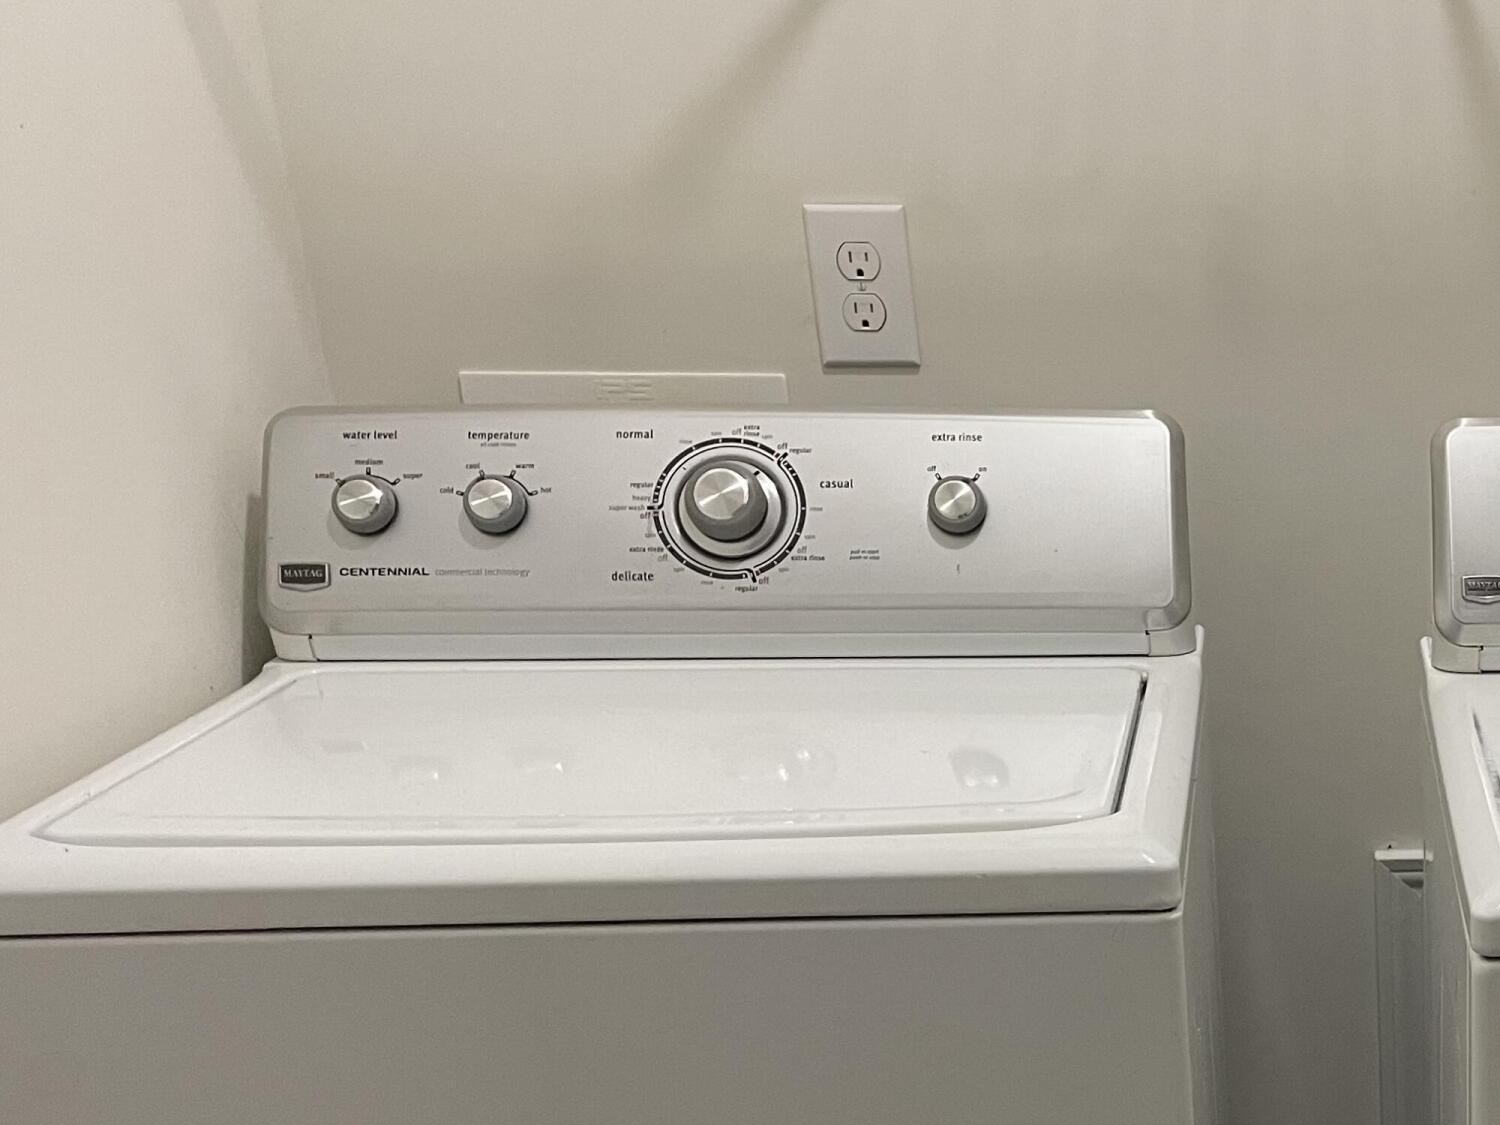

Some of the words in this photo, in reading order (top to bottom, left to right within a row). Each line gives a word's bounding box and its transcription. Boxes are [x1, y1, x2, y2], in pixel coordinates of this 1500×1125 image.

[343, 431, 371, 440] water
[373, 430, 398, 440] level
[468, 431, 530, 441] temperature
[616, 429, 654, 439] normal
[732, 428, 742, 436] off
[931, 432, 956, 442] extra
[958, 432, 983, 442] rinse
[789, 447, 812, 455] regular
[354, 458, 384, 466] medium
[315, 471, 335, 479] small
[819, 478, 854, 489] casual
[440, 486, 455, 494] cold
[639, 511, 652, 520] off
[796, 545, 808, 554] off
[282, 568, 324, 579] MAYTAG
[339, 567, 430, 577] CENTENNIAL
[434, 567, 483, 577] commercial
[611, 570, 655, 582] delicate
[758, 576, 770, 585] off
[734, 585, 759, 593] regular
